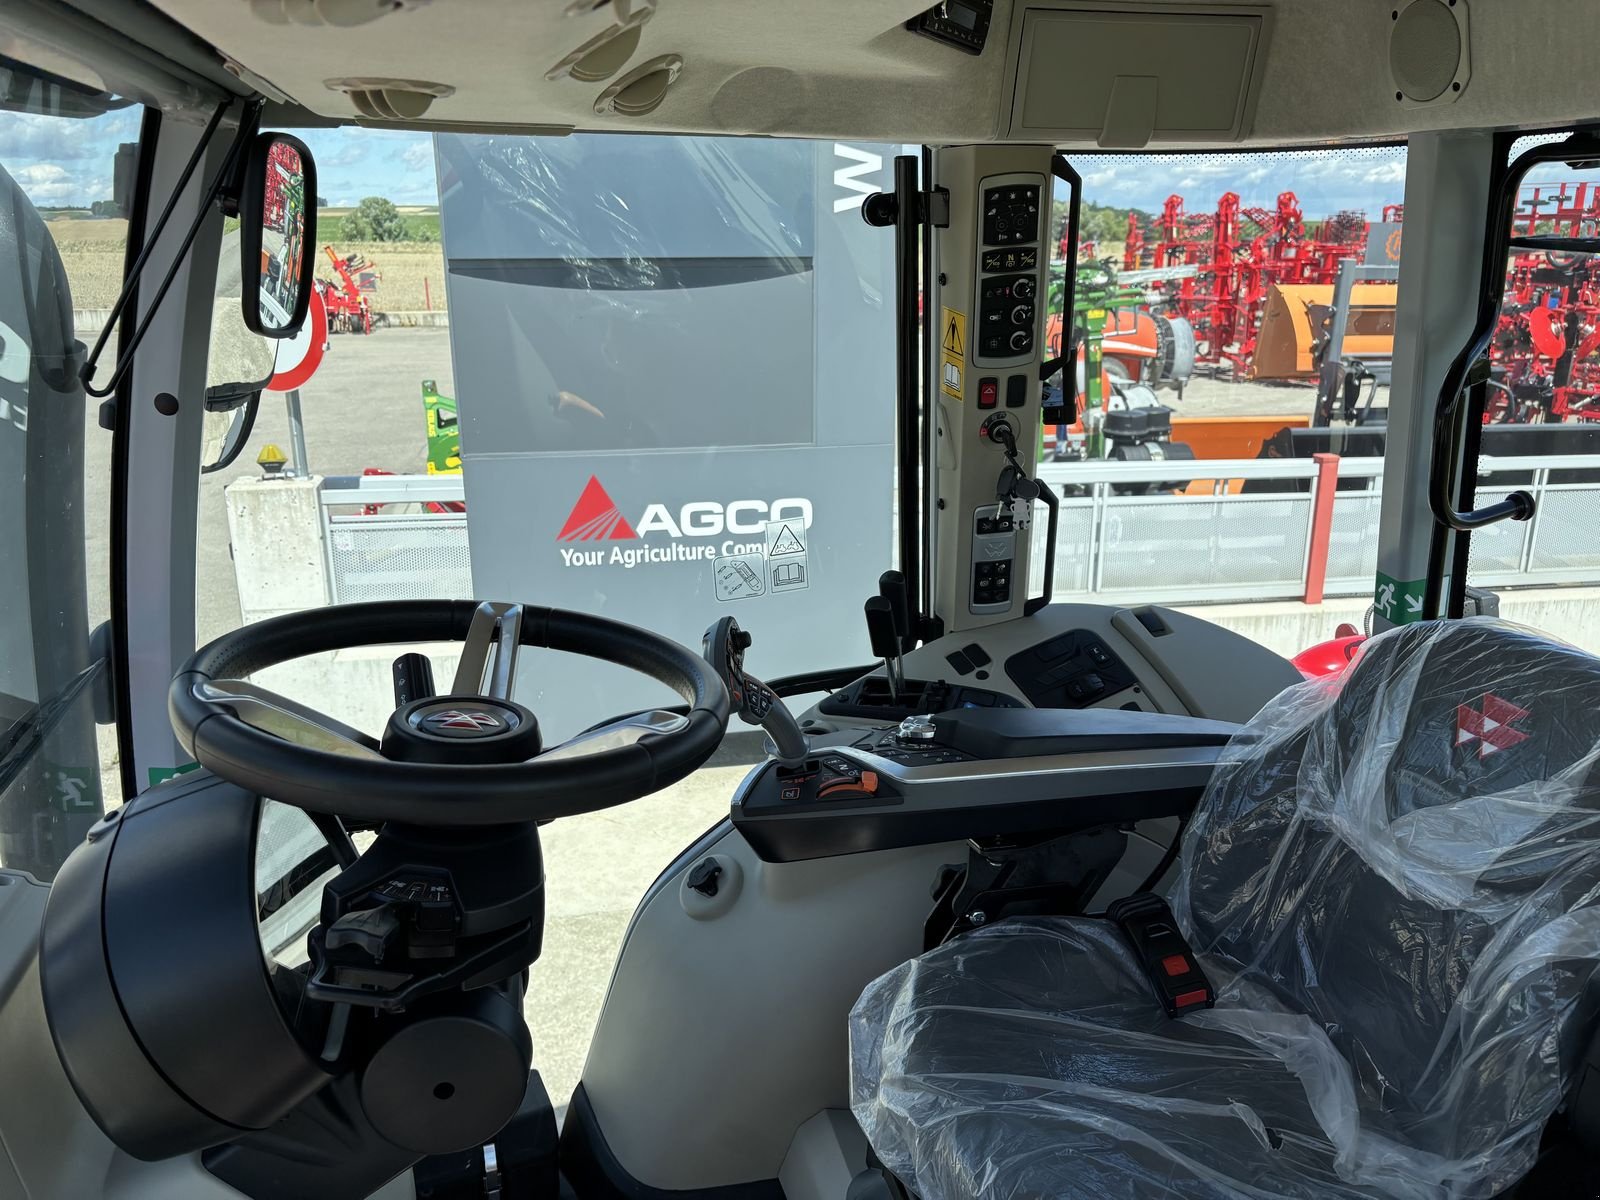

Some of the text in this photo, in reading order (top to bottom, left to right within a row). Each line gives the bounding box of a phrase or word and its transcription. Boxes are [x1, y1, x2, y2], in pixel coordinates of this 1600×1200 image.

[635, 497, 813, 538] AGCO
[560, 547, 604, 567] Your
[609, 541, 715, 568] Agriculture
